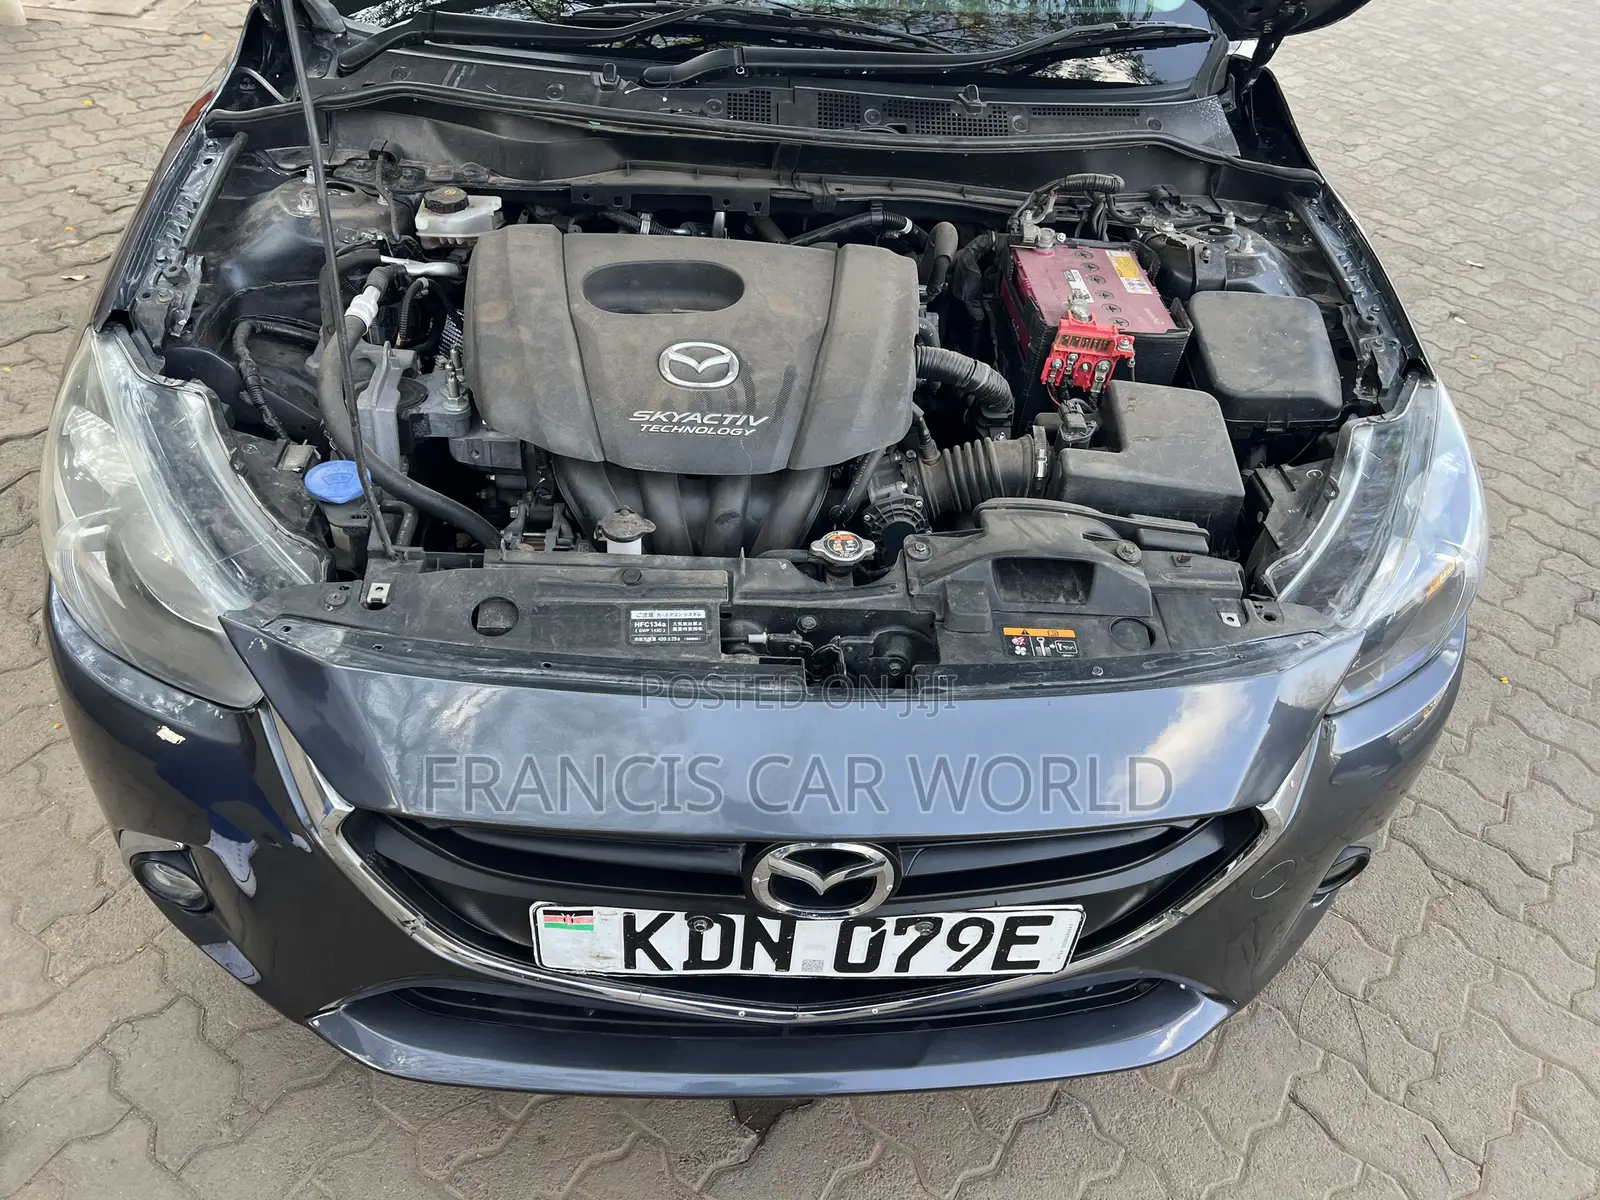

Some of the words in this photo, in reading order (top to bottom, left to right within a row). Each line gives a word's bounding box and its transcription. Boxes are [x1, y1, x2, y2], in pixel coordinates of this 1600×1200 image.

[629, 410, 769, 426] SKYACTIV
[640, 424, 756, 436] TECHNOLOGY
[623, 911, 796, 973] KDN
[833, 915, 1055, 973] 079E
